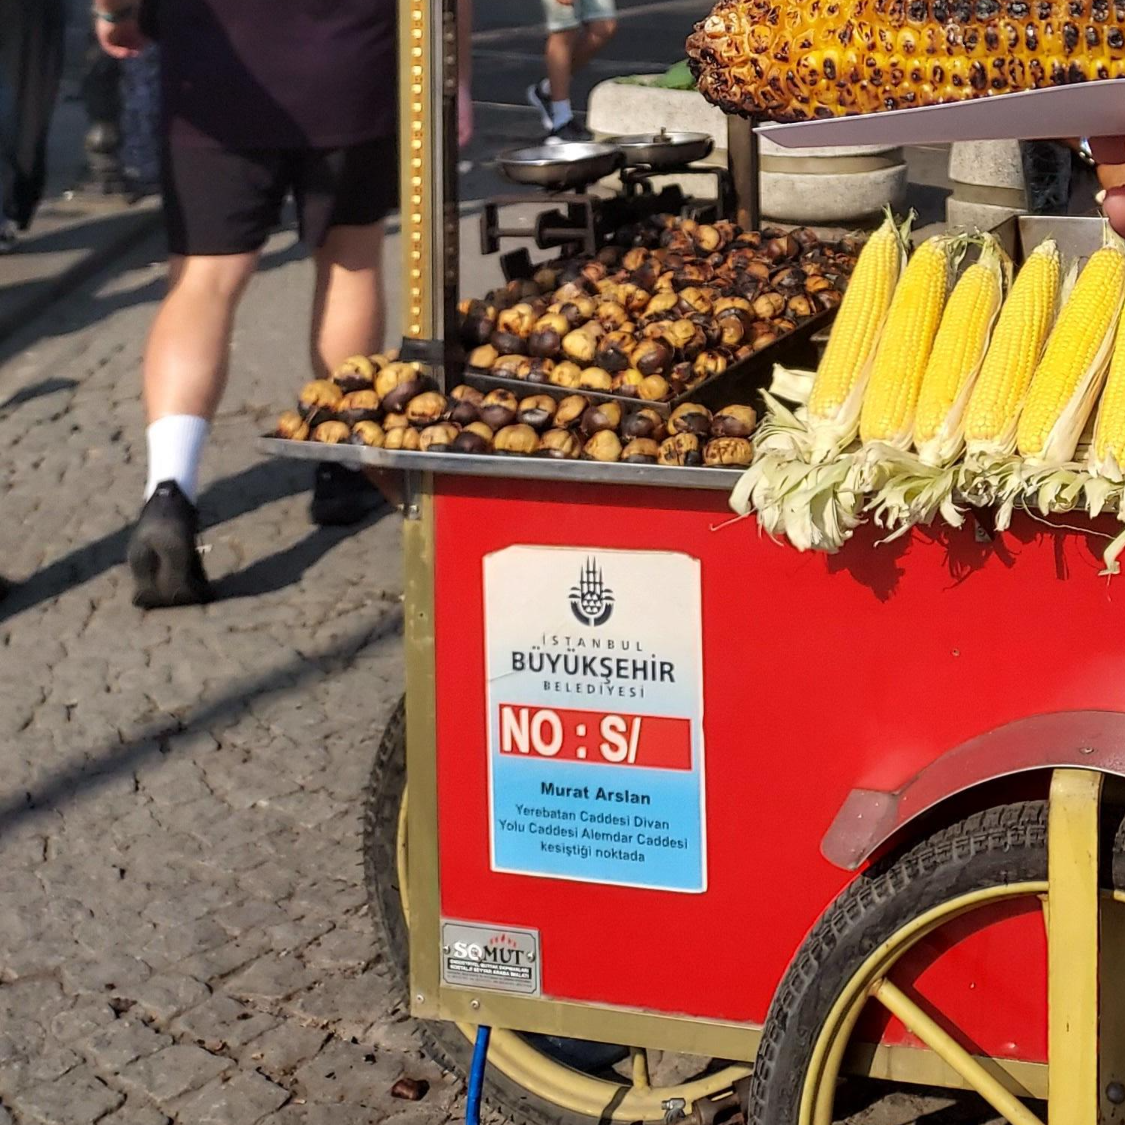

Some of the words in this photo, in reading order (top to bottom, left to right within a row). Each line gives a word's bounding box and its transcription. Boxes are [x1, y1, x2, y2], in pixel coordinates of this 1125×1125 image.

[541, 633, 644, 652] İSTANBUL
[511, 645, 676, 685] BÜYÜKŞEHİR
[543, 680, 645, 699] BELEDİYESİ
[501, 706, 563, 757] NO
[541, 781, 589, 799] Murat
[595, 786, 651, 806] Arslan
[515, 803, 576, 822] Yerebatan
[580, 809, 630, 827] Caddesi
[634, 815, 669, 831] Divan
[499, 819, 526, 833] Yolu
[528, 823, 578, 839] Caddesi
[581, 827, 633, 844] Alemdar
[636, 832, 688, 850] Caddesi
[540, 840, 592, 859] kesiştiği
[595, 848, 645, 863] noktada
